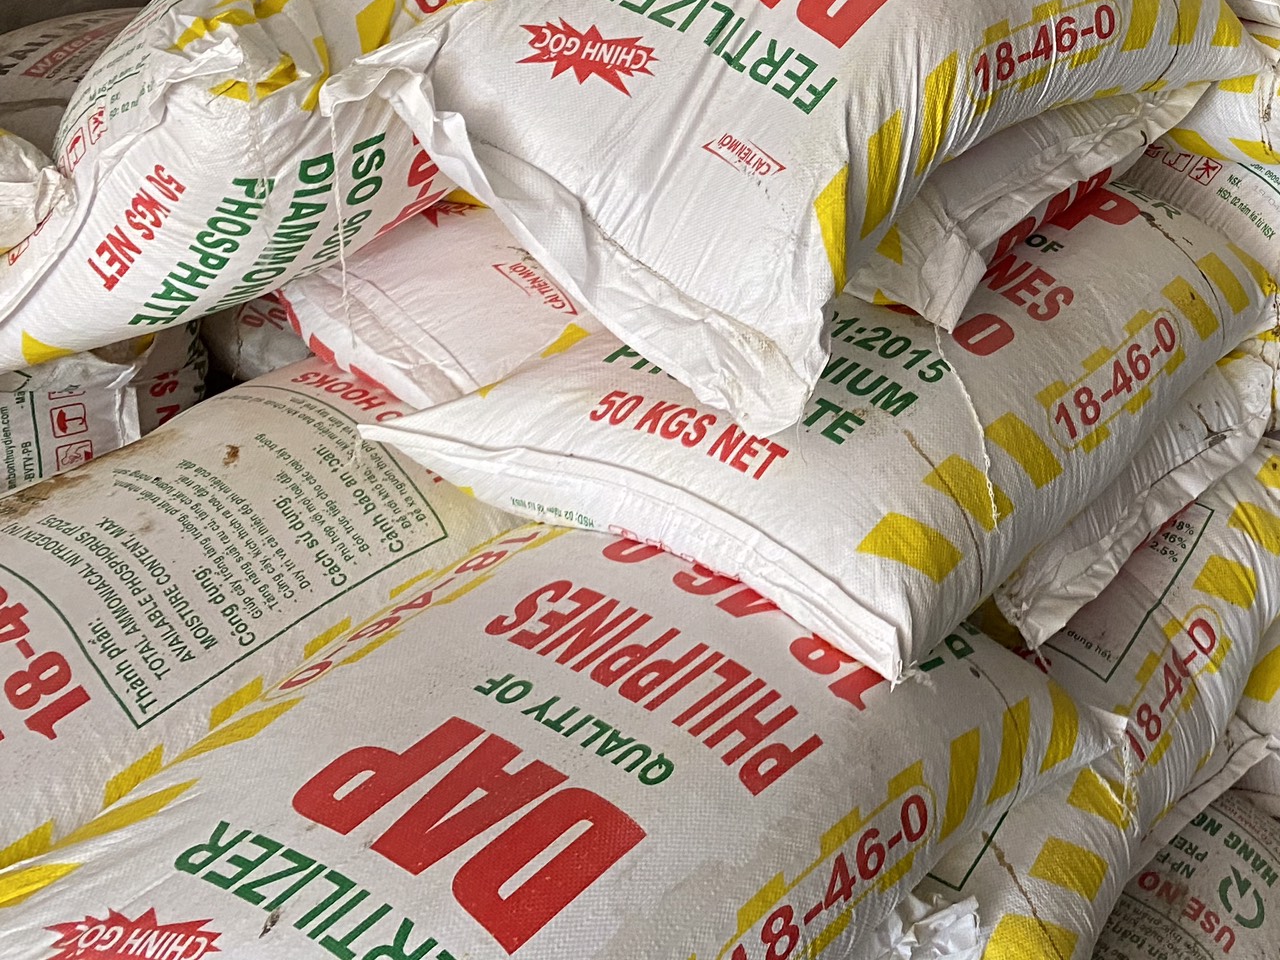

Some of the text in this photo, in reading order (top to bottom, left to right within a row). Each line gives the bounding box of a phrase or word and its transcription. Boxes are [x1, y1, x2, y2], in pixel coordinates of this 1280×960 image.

[533, 23, 651, 72] CHÍNH GỐC
[974, 3, 1117, 95] 18-46-0
[347, 132, 386, 205] ISO
[718, 134, 773, 175] CẢI TIẾN MỚI
[1227, 174, 1242, 188] NSX:
[87, 163, 187, 292] 50 KGS NET
[1025, 234, 1064, 253] OF
[1216, 187, 1275, 240] HSD: 02 năm kể NSX
[128, 177, 275, 326] PHOSPHATE
[510, 263, 534, 281] MỚI
[544, 290, 565, 309] CẢI
[292, 372, 385, 410] HOOKS
[1054, 318, 1177, 439] 18-46-0
[589, 389, 790, 481] 50 KGS NET
[251, 432, 370, 554] Bón trực tiếp cho các loại cây trồng.
[297, 495, 317, 514] mọi
[340, 472, 357, 487] an
[350, 487, 377, 516] báo
[372, 484, 401, 514] nơi khô
[382, 469, 407, 495] nguồn
[135, 488, 263, 620] Giúp cây trồng tăng trưởng, phát triển
[171, 489, 278, 610] Tăng năng suất rau củ, tăng chất
[191, 483, 294, 598] Cứng cây, kích thích ra hoa, đậu
[192, 465, 310, 589] Duy và cải thiện độ phì của
[271, 493, 346, 586] Cách sử dụng:
[308, 511, 326, 528] với
[322, 524, 341, 545] hợp
[335, 543, 354, 562] Phù
[373, 514, 403, 552] Cảnh
[1147, 538, 1177, 562] 2.5%
[1159, 528, 1186, 548] 46%
[76, 532, 146, 595] PHOSPHORUS
[96, 517, 216, 649] MOISTURE CONTENT, MAX.
[20, 528, 170, 680] TOTAL AMMONIACAL NITROGEN
[138, 595, 195, 662] AVAILABLE
[190, 563, 255, 646] Công dụng:
[279, 532, 538, 692] 18-46-0
[88, 618, 156, 714] Thành phần:
[484, 579, 823, 797] PHILIPPINES
[474, 676, 675, 786] QUALITY OF
[292, 716, 647, 955] DAP
[1138, 869, 1234, 952] USE NO
